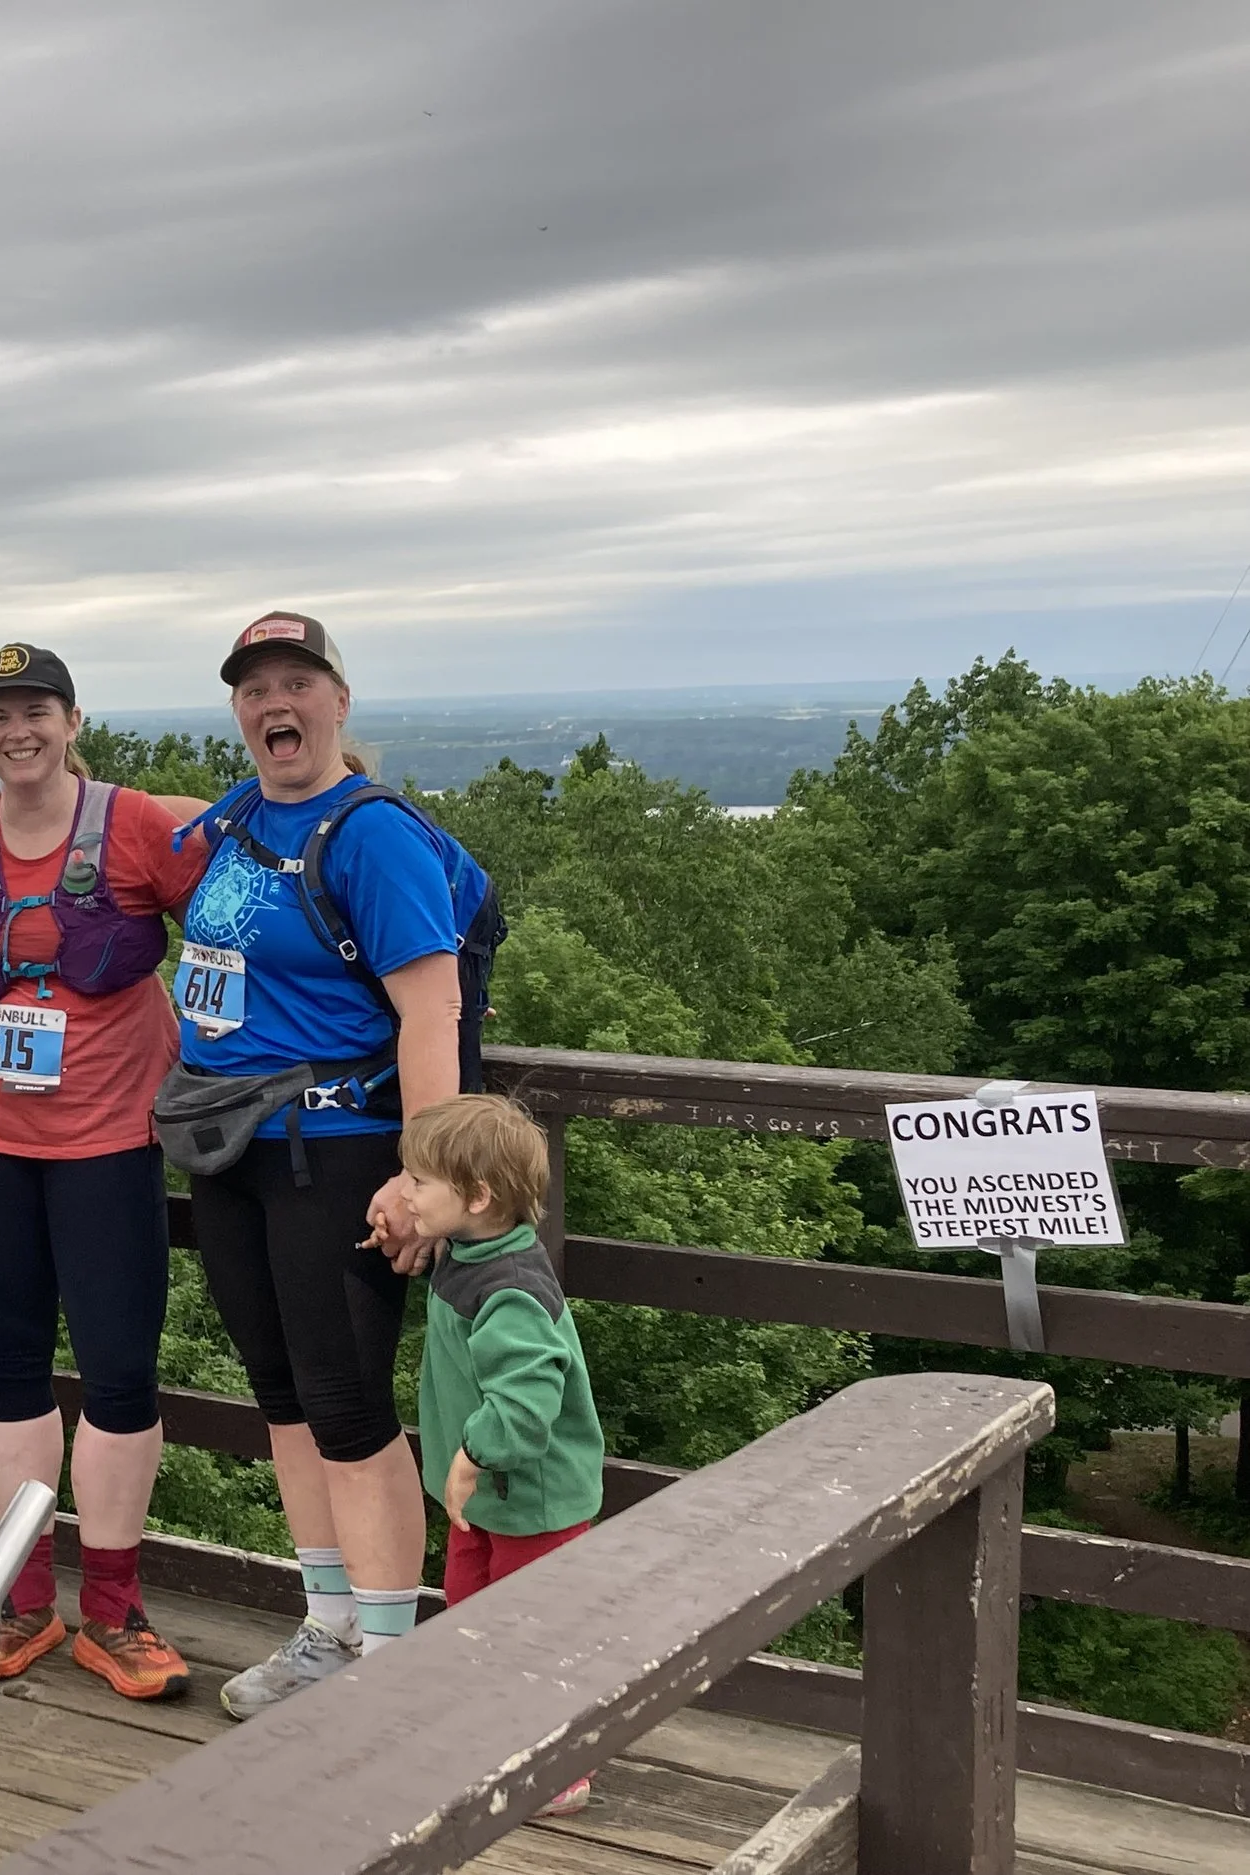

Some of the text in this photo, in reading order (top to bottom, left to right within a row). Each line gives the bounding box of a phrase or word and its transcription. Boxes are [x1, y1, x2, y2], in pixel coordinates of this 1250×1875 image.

[184, 967, 228, 1015] 614
[892, 1102, 1092, 1142] CONGRATS
[905, 1170, 1099, 1196] YOU ASCENDED
[909, 1193, 1107, 1218] THE MIDWEST’S
[917, 1215, 1110, 1239] STEEPEST MILE!
